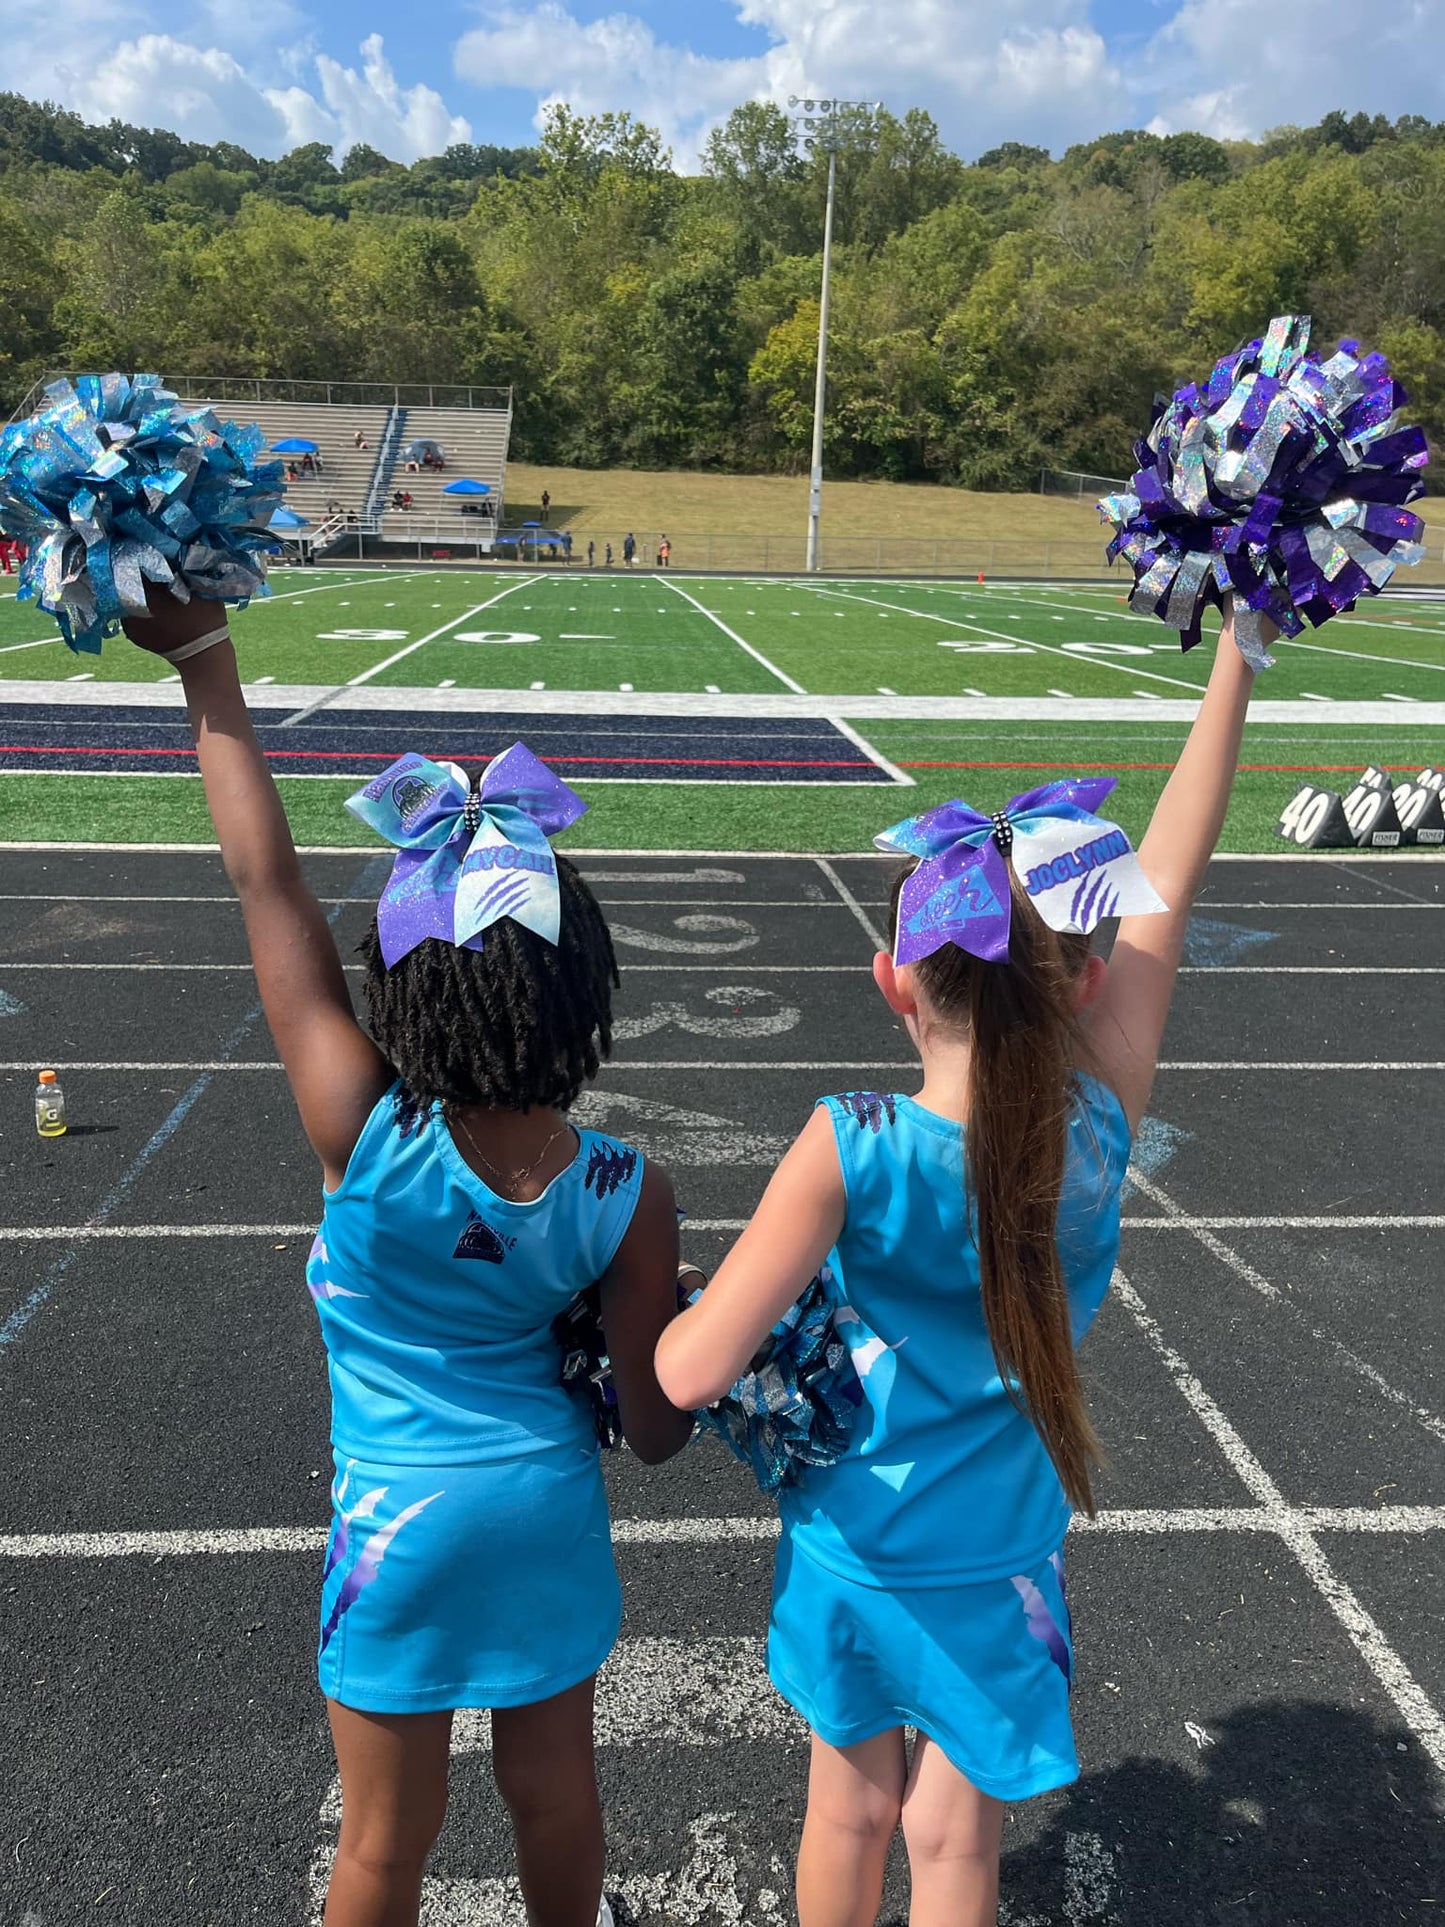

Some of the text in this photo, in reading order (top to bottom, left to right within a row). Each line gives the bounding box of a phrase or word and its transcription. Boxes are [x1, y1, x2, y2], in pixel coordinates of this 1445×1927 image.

[1279, 786, 1329, 844] 40
[1024, 829, 1131, 896] JOCLYNN
[46, 1108, 57, 1120] G
